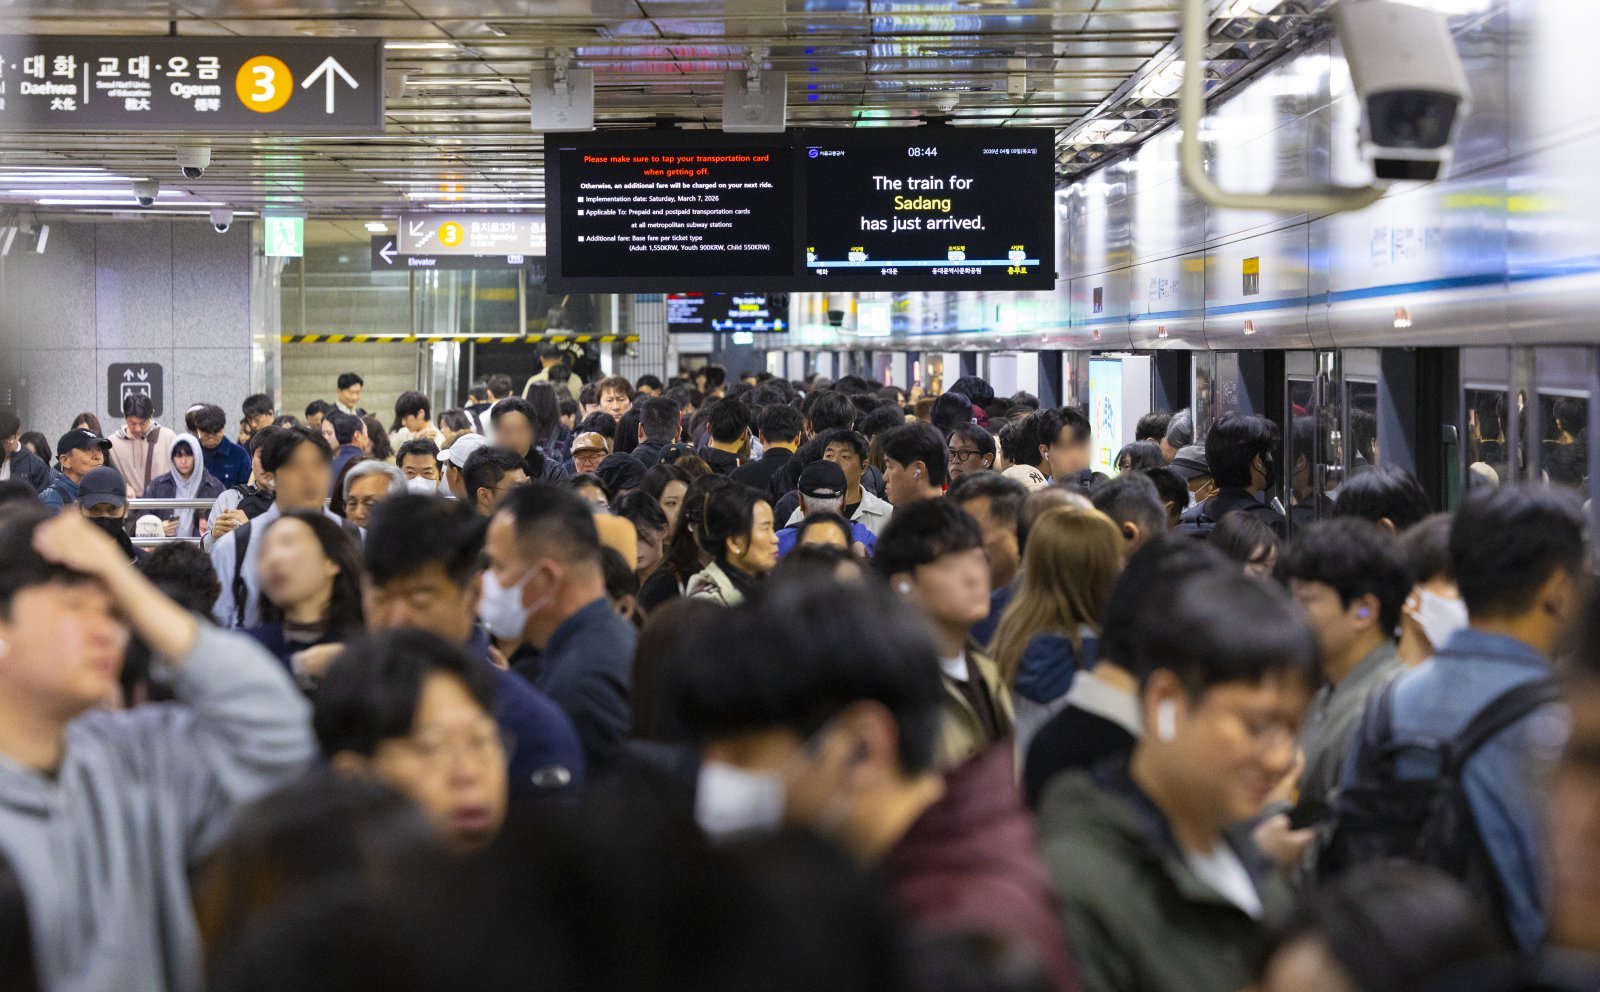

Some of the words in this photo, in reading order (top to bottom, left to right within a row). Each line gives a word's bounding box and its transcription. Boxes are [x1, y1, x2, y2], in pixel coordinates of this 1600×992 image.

[20, 81, 78, 95] Daehwa
[250, 65, 276, 103] 3
[170, 82, 221, 99] Ogeum
[908, 147, 938, 157] 08:44
[583, 155, 609, 163] Please
[609, 155, 631, 163] make
[651, 155, 660, 163] to
[661, 155, 675, 164] tap
[676, 156, 695, 164] your
[696, 154, 751, 164] transportation
[752, 154, 770, 162] card
[643, 168, 665, 176] when
[666, 168, 695, 178] getting
[695, 167, 710, 176] off.
[579, 182, 613, 190] Otherwise,
[682, 181, 691, 189] be
[691, 181, 717, 190] charged
[758, 181, 774, 189] ride.
[872, 175, 903, 191] The
[906, 175, 944, 191] train
[948, 174, 974, 191] for
[585, 195, 632, 204] Implementation
[632, 195, 648, 203] date:
[648, 195, 677, 204] Saturday,
[677, 195, 697, 203] March
[697, 195, 704, 204] 7,
[894, 195, 952, 213] Sadang
[585, 208, 617, 217] Applicable
[617, 208, 628, 216] To:
[628, 208, 651, 217] Prepaid
[664, 208, 691, 217] postpaid
[691, 208, 734, 216] transportation
[734, 207, 751, 215] cards
[638, 221, 647, 229] all
[647, 221, 685, 230] metropolitan
[685, 221, 709, 230] subway
[709, 221, 733, 229] stations
[860, 215, 888, 231] has
[891, 215, 922, 233] just
[926, 214, 986, 231] arrived.
[445, 225, 457, 243] 3
[585, 234, 617, 242] Additional
[617, 234, 631, 242] fare:
[631, 234, 647, 242] Base
[646, 234, 660, 242] fare
[660, 235, 671, 243] per
[671, 234, 689, 242] ticket
[689, 234, 704, 243] type
[628, 244, 648, 252] (Adult
[648, 244, 680, 252] 1,550KRW,
[680, 244, 699, 252] Youth
[699, 244, 726, 252] 900KRW,
[743, 243, 771, 252] 550KRW)
[408, 257, 436, 267] Elevator
